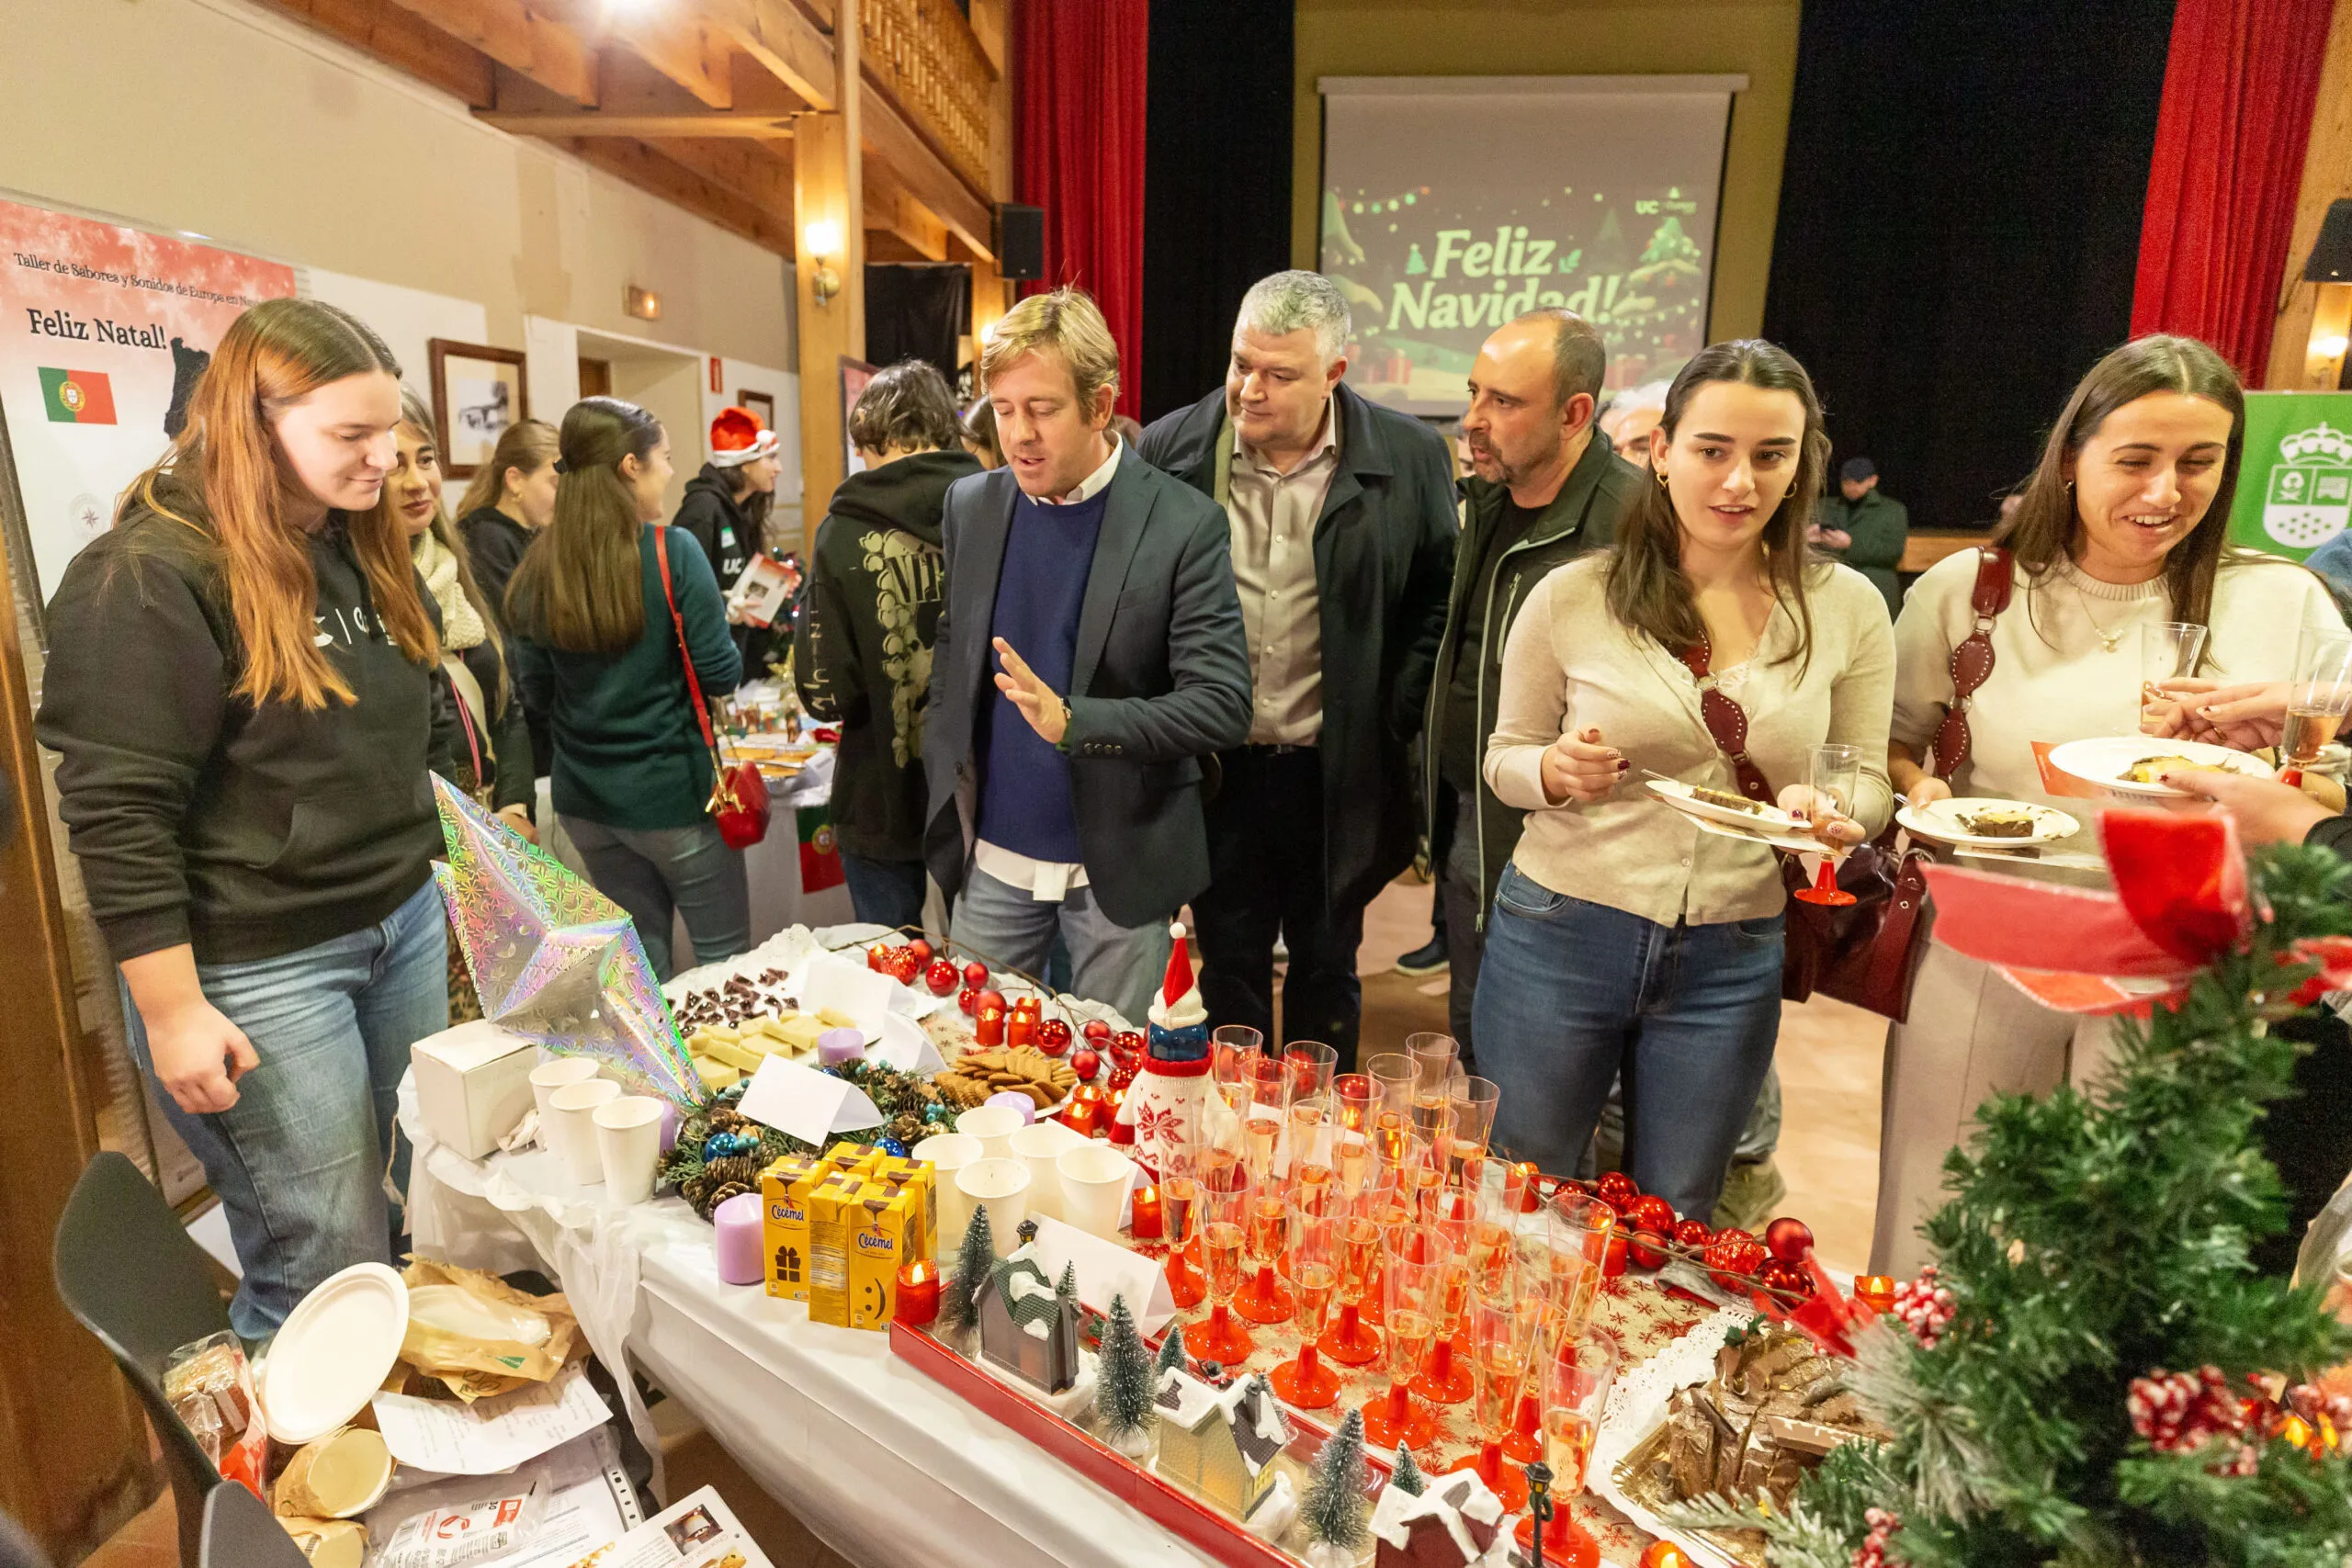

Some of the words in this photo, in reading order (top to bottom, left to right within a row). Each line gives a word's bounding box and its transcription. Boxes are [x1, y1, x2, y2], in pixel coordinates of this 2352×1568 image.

[1430, 225, 1557, 279] Feliz
[14, 253, 51, 272] Taller
[53, 259, 70, 275] de
[71, 263, 119, 284] Sabores
[121, 276, 130, 288] y
[130, 274, 175, 293] Sonidos
[175, 283, 188, 297] de
[188, 286, 225, 304] Europa
[225, 295, 238, 305] en
[26, 308, 90, 341] Feliz
[93, 318, 167, 349] Natal!
[771, 1204, 805, 1222] Cécémel
[858, 1233, 894, 1250] Cécémel
